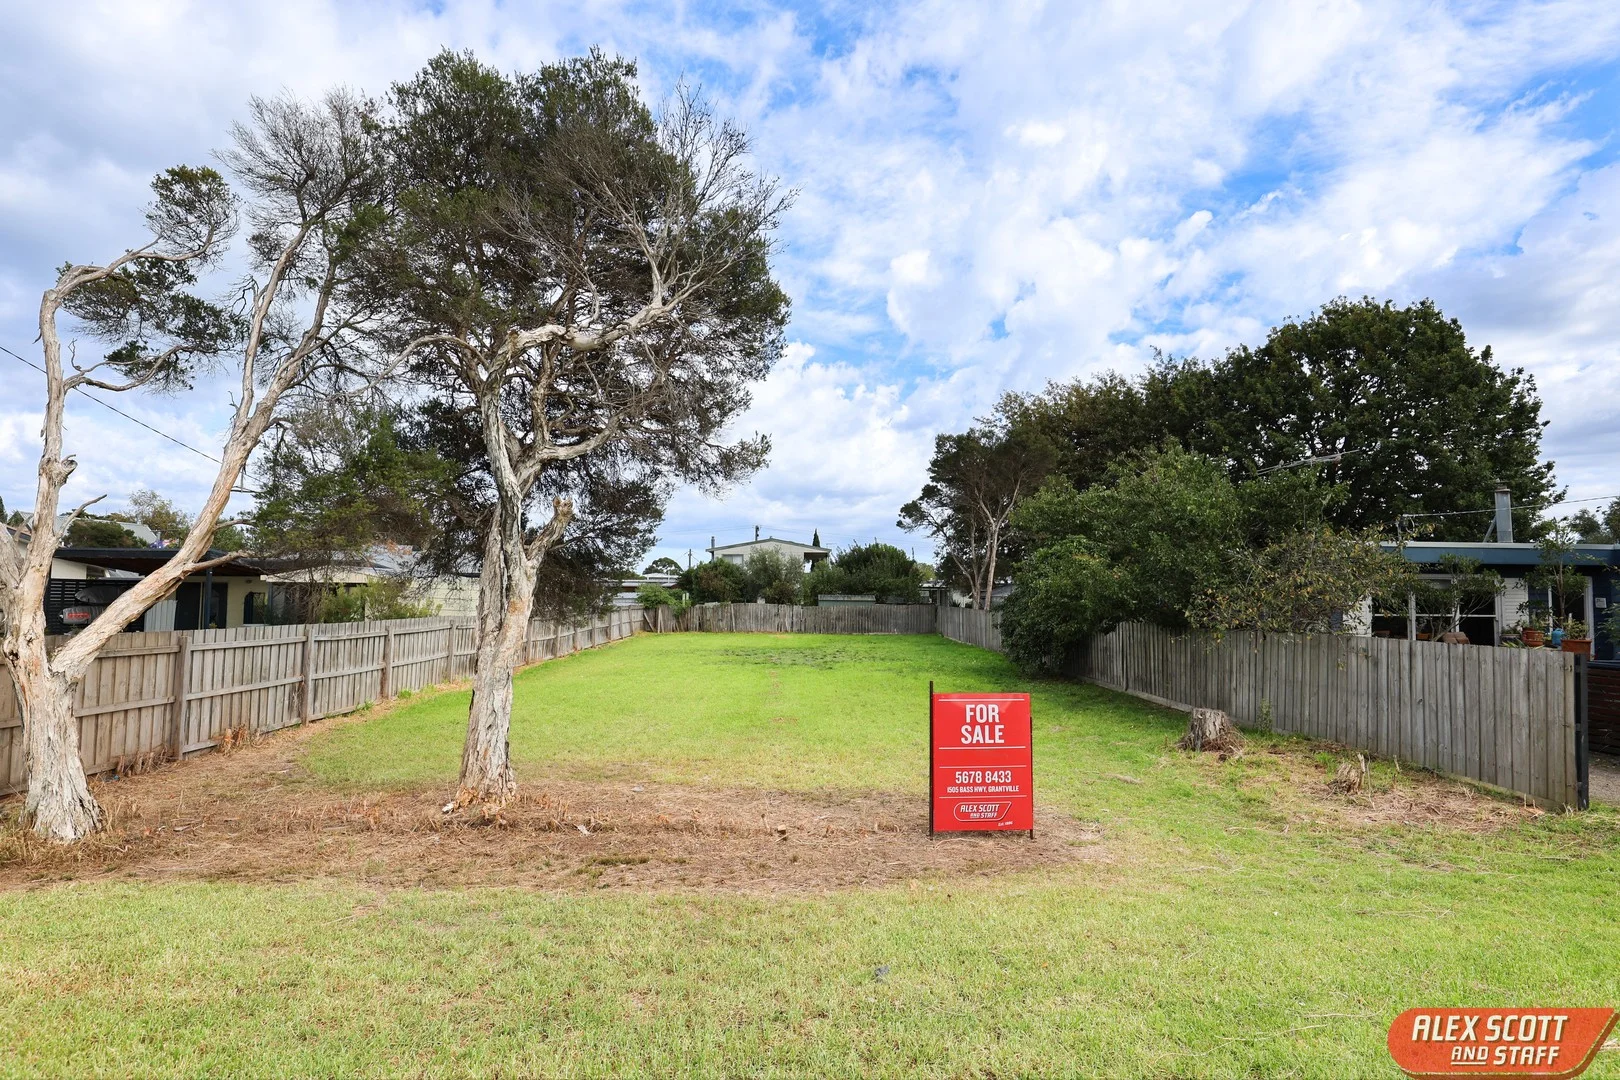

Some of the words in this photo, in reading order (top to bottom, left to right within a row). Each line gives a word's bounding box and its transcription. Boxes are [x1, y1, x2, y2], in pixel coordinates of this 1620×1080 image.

[965, 704, 999, 723] FOR
[961, 725, 1005, 744] SALE
[955, 771, 982, 783] 5678
[985, 770, 1012, 783] 8433
[978, 804, 999, 812] SCOTT
